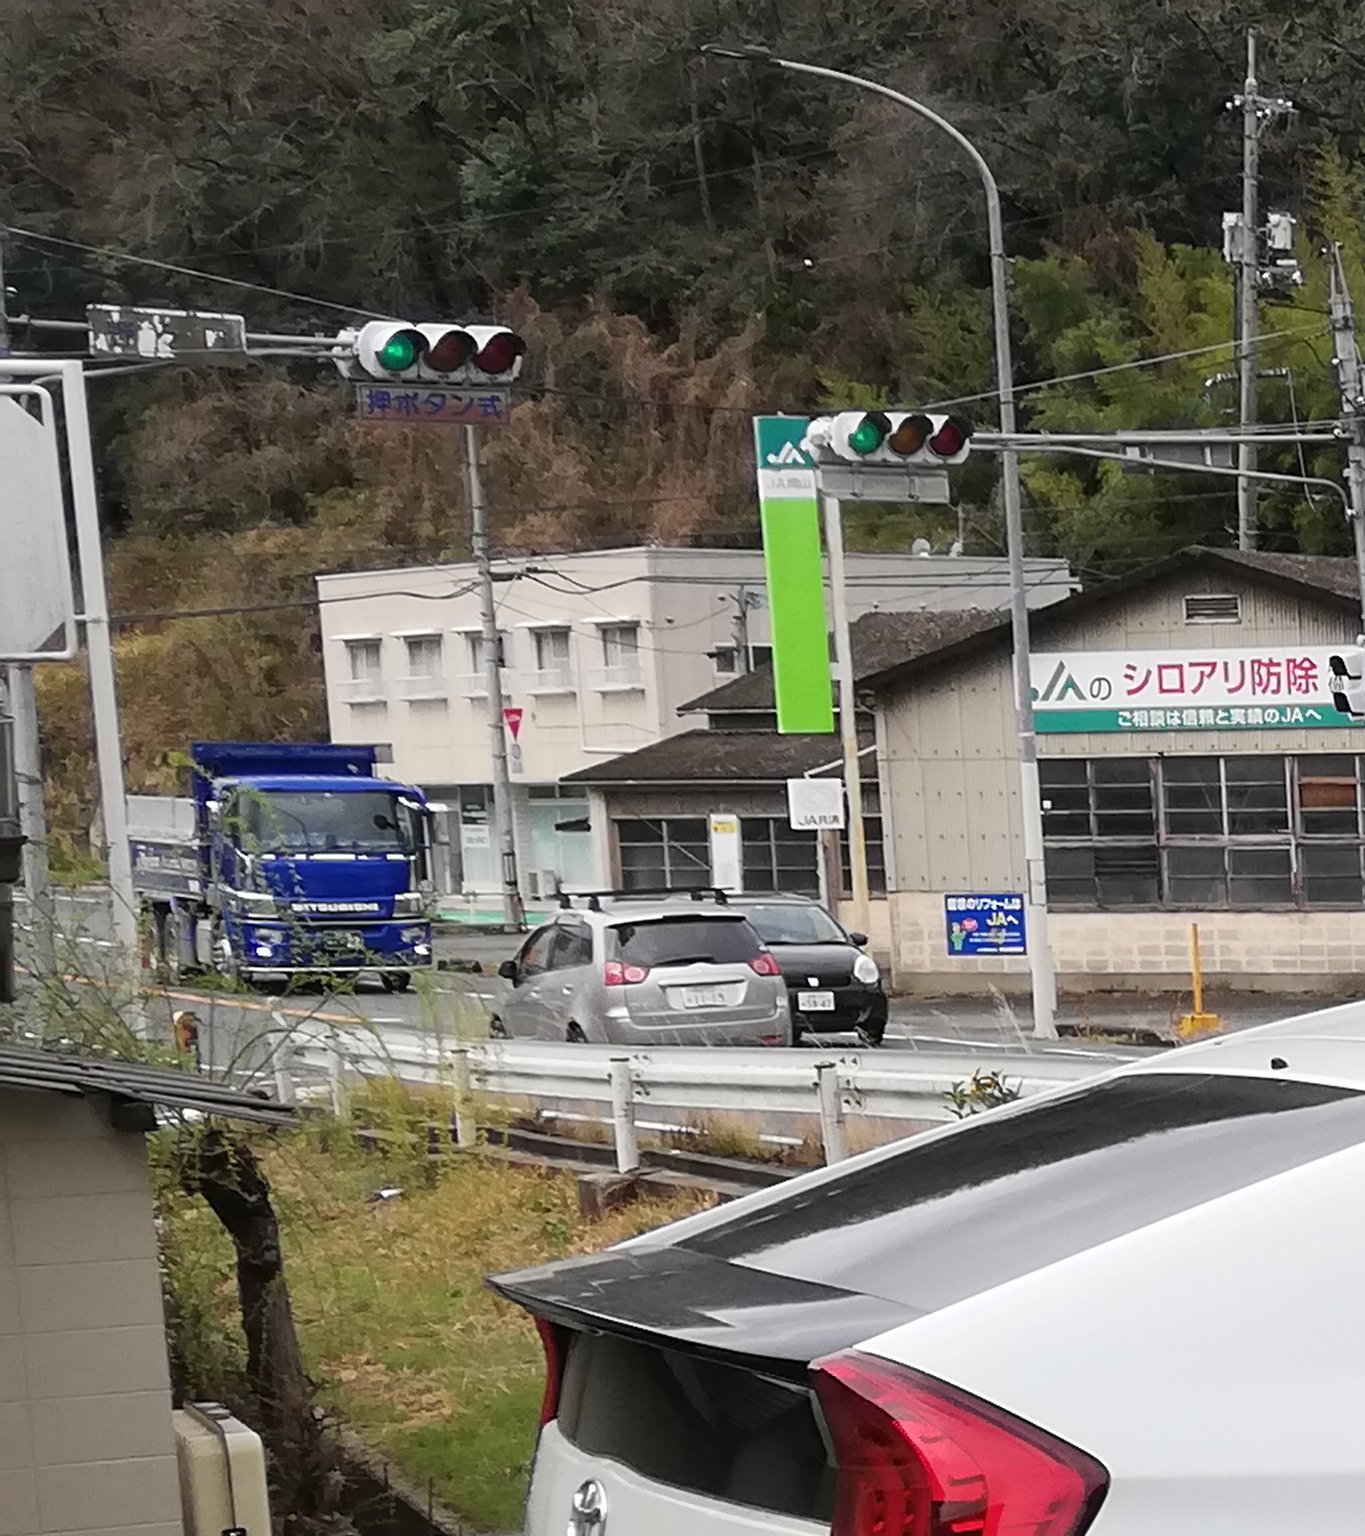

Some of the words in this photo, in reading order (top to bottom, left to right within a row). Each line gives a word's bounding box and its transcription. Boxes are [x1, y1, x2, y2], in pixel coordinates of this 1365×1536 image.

[366, 389, 502, 418] 押ボタン式
[1123, 656, 1319, 697] シロアリ防除
